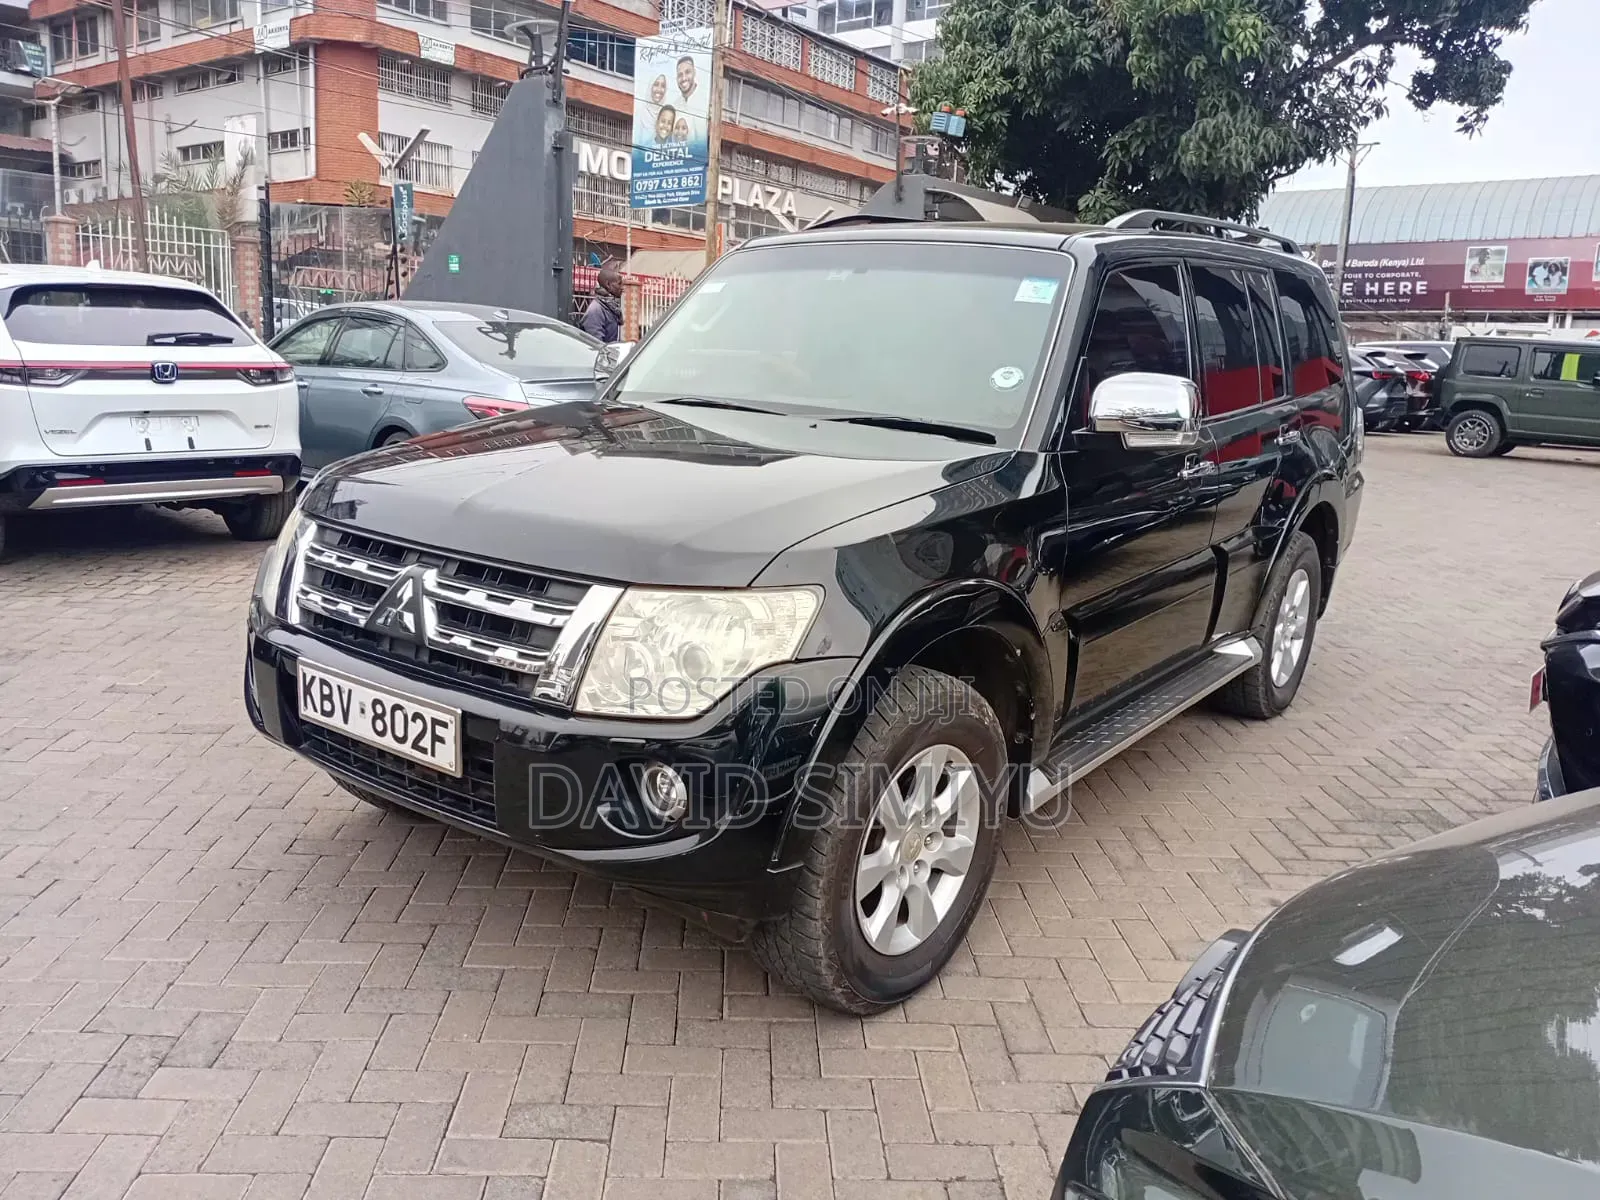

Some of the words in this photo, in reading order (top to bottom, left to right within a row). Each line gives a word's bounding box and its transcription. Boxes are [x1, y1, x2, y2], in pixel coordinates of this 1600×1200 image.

[644, 147, 693, 162] DENTAL
[652, 160, 684, 168] EXPERIENCE
[635, 180, 660, 191] 0797
[661, 177, 679, 189] 432
[681, 175, 700, 187] 862
[717, 174, 798, 217] PLAZA
[1351, 259, 1379, 268] Baroda
[1379, 258, 1410, 269] (Kenya)
[1365, 281, 1428, 297] HERE
[301, 671, 352, 725] KBV
[370, 698, 449, 758] 802F
